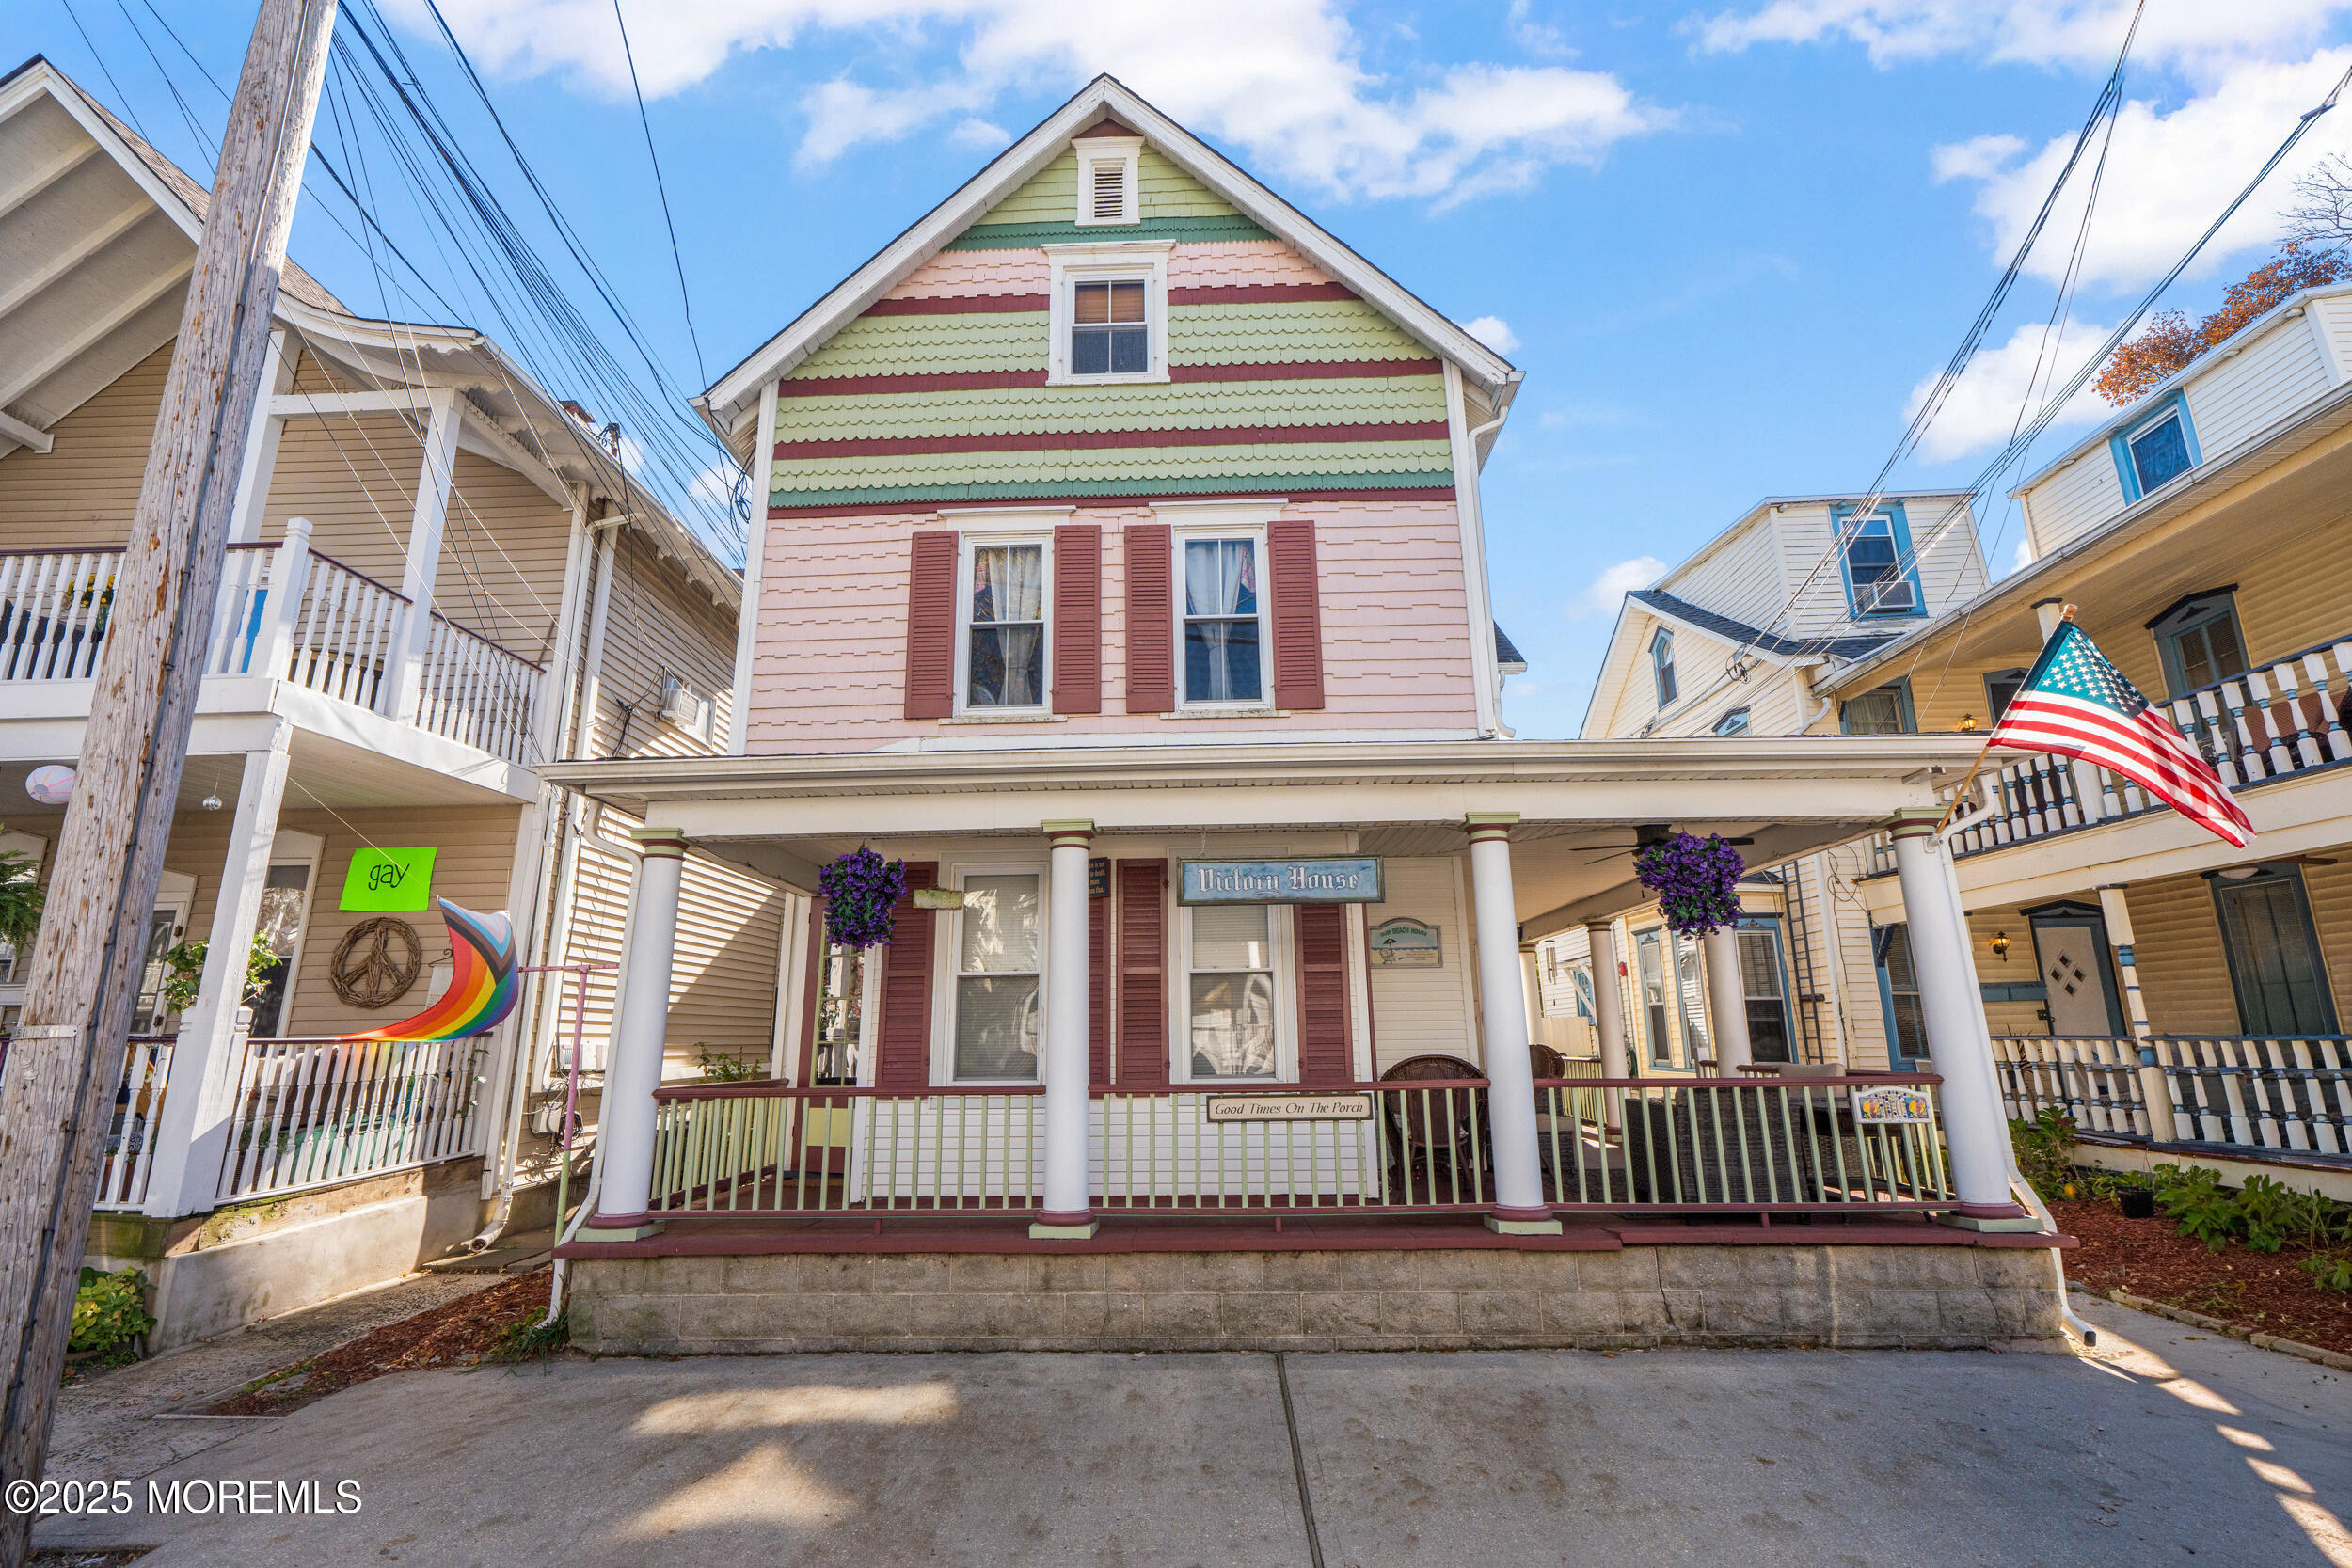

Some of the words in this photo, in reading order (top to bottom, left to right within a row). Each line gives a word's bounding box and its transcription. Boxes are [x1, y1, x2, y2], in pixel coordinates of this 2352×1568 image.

[368, 863, 410, 891] gay
[1198, 866, 1280, 896] Victory
[1286, 864, 1360, 891] House
[1392, 927, 1410, 935] BEACH
[1215, 1103, 1245, 1115] Good
[1249, 1103, 1281, 1114] Times
[1285, 1102, 1305, 1114] On
[1310, 1102, 1329, 1113] The
[1332, 1101, 1363, 1113] Porch
